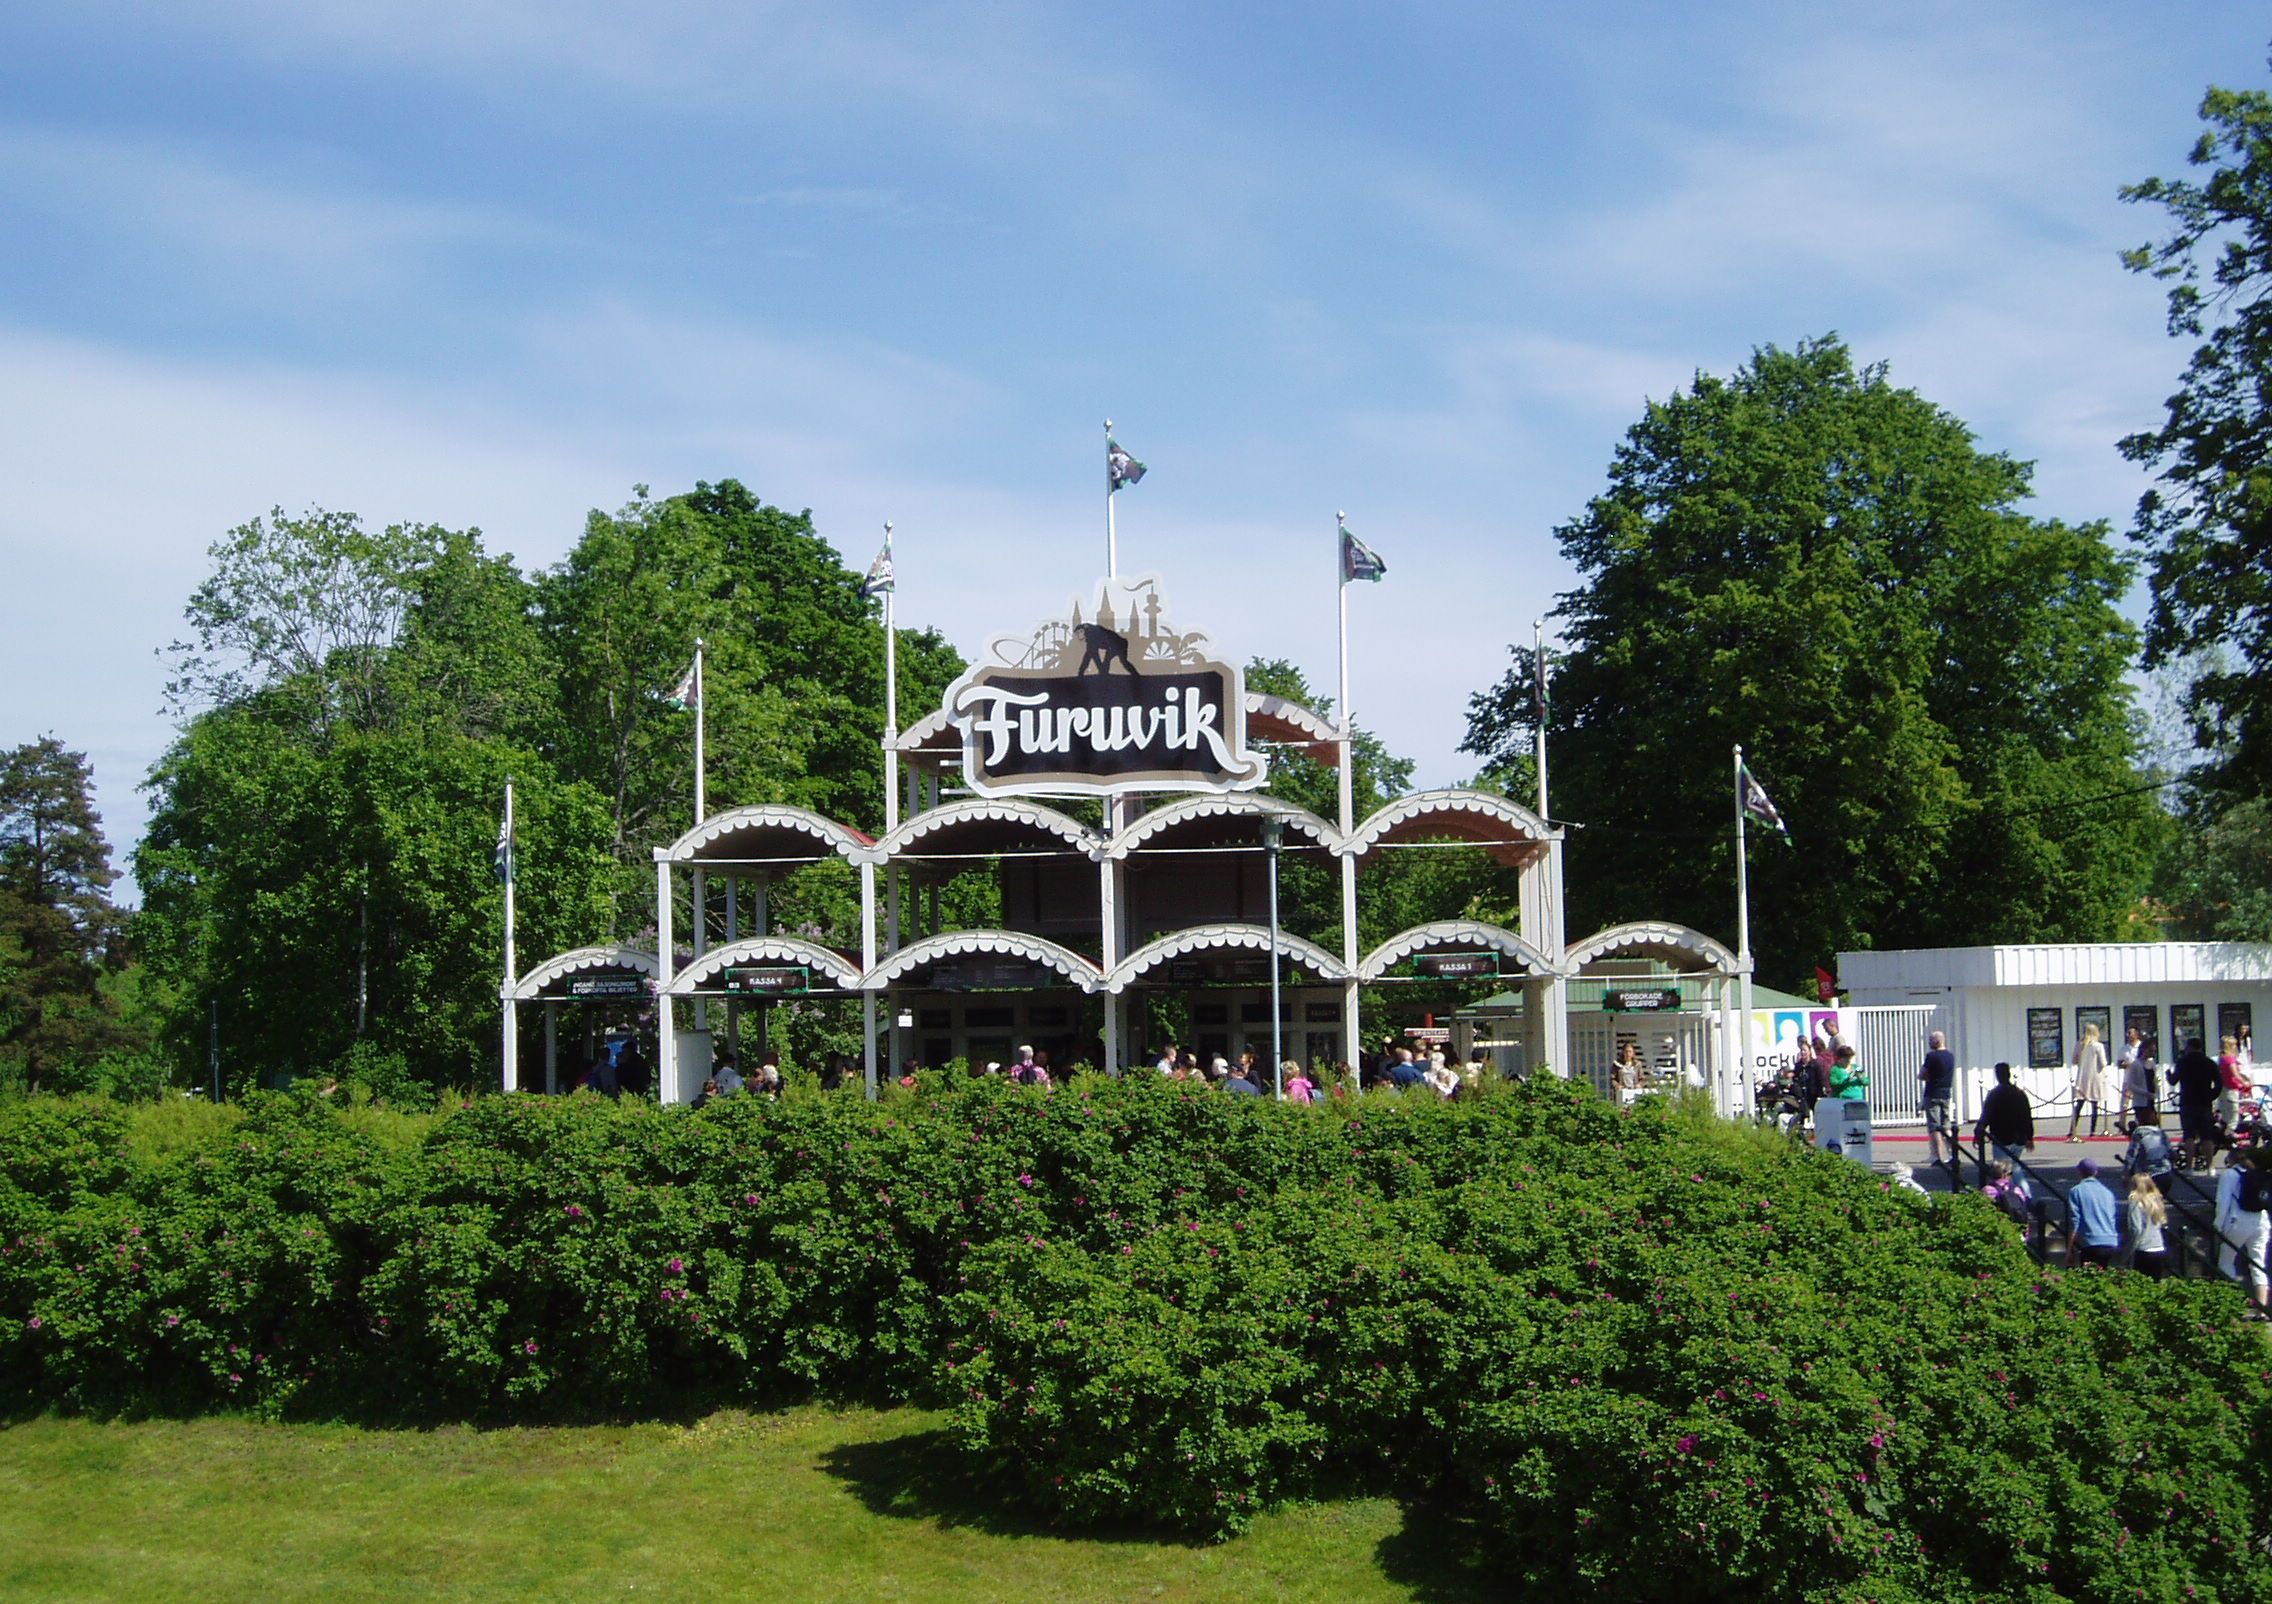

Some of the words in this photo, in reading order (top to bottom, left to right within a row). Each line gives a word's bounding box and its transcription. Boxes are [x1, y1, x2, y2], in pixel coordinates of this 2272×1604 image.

[957, 686, 1251, 774] Furuvik
[1439, 963, 1467, 971] KASSA
[749, 977, 776, 985] KASSA
